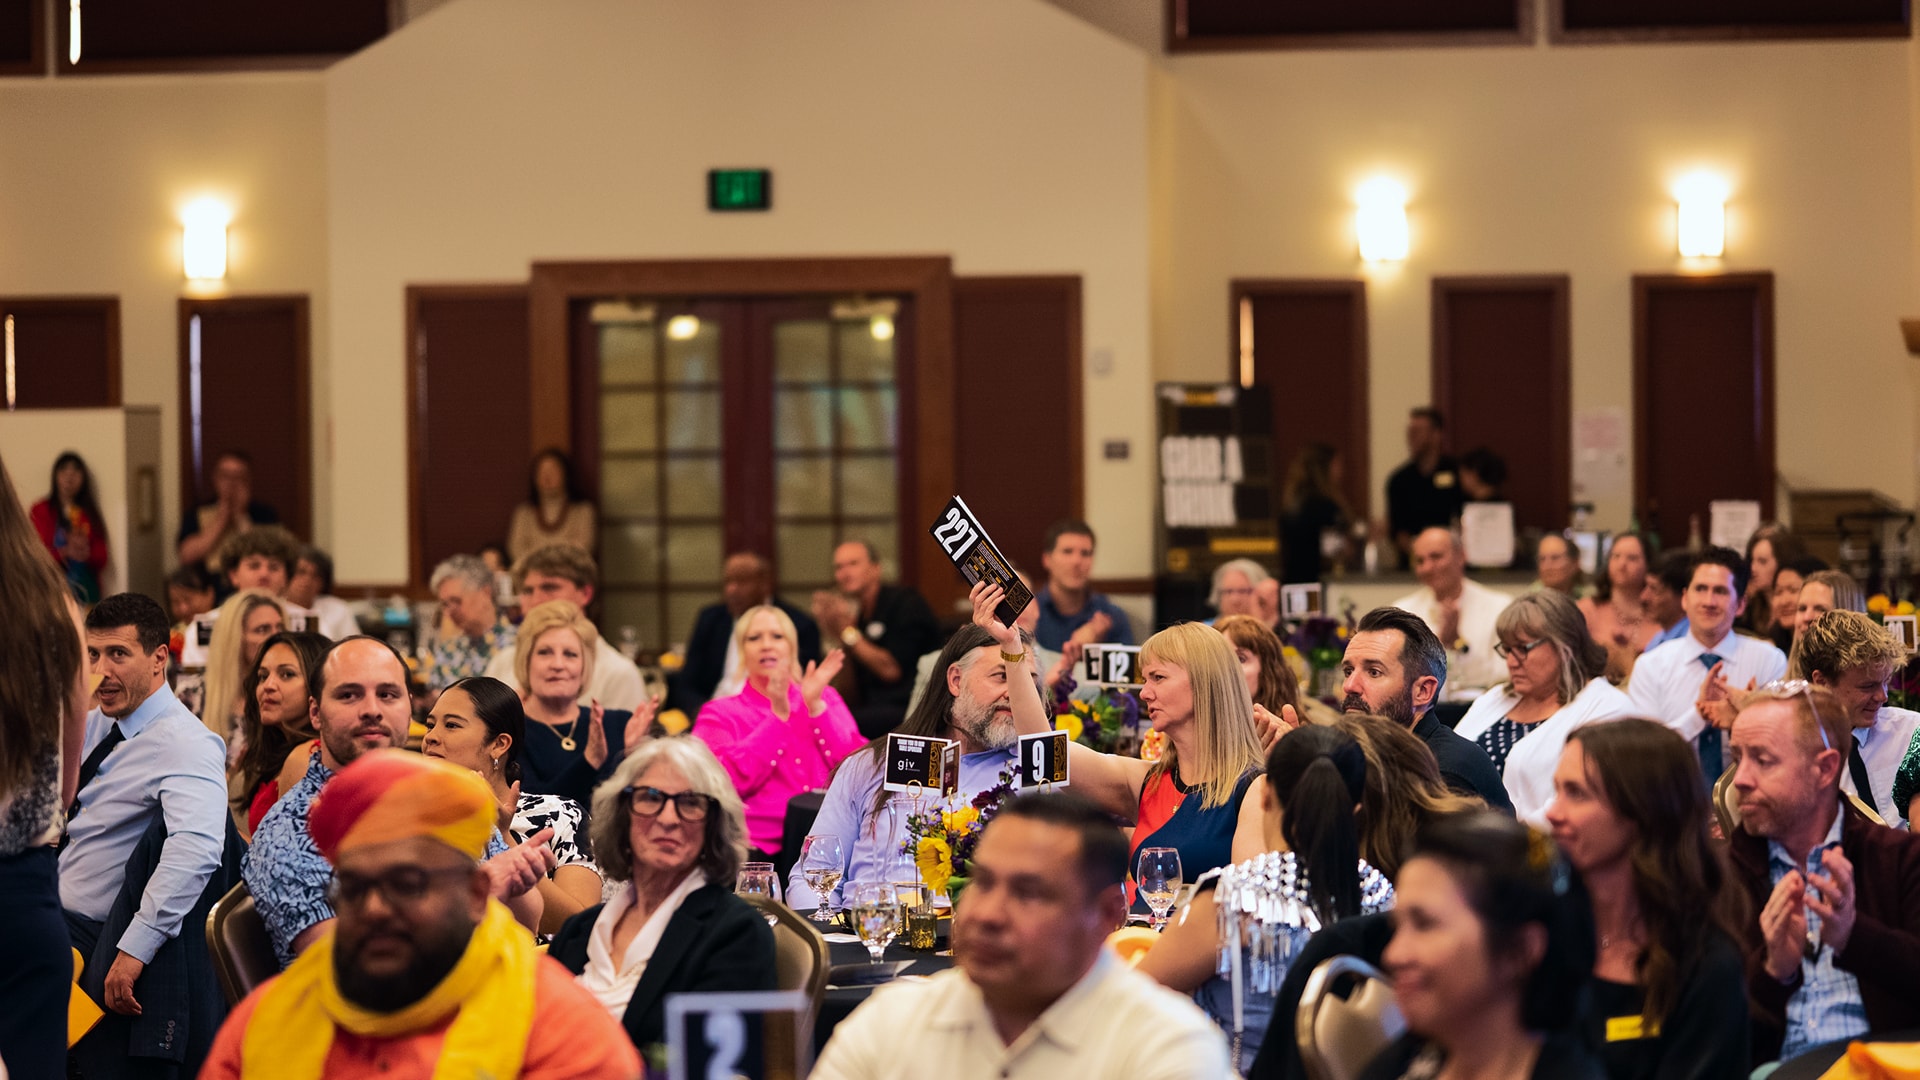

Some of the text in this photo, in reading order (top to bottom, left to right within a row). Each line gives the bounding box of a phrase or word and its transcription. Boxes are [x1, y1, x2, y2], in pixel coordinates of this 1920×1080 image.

[1162, 437, 1243, 481] GRAB A
[1164, 484, 1236, 526] DRINK
[933, 507, 979, 562] 227
[1108, 652, 1130, 682] 12
[1032, 740, 1045, 782] 9
